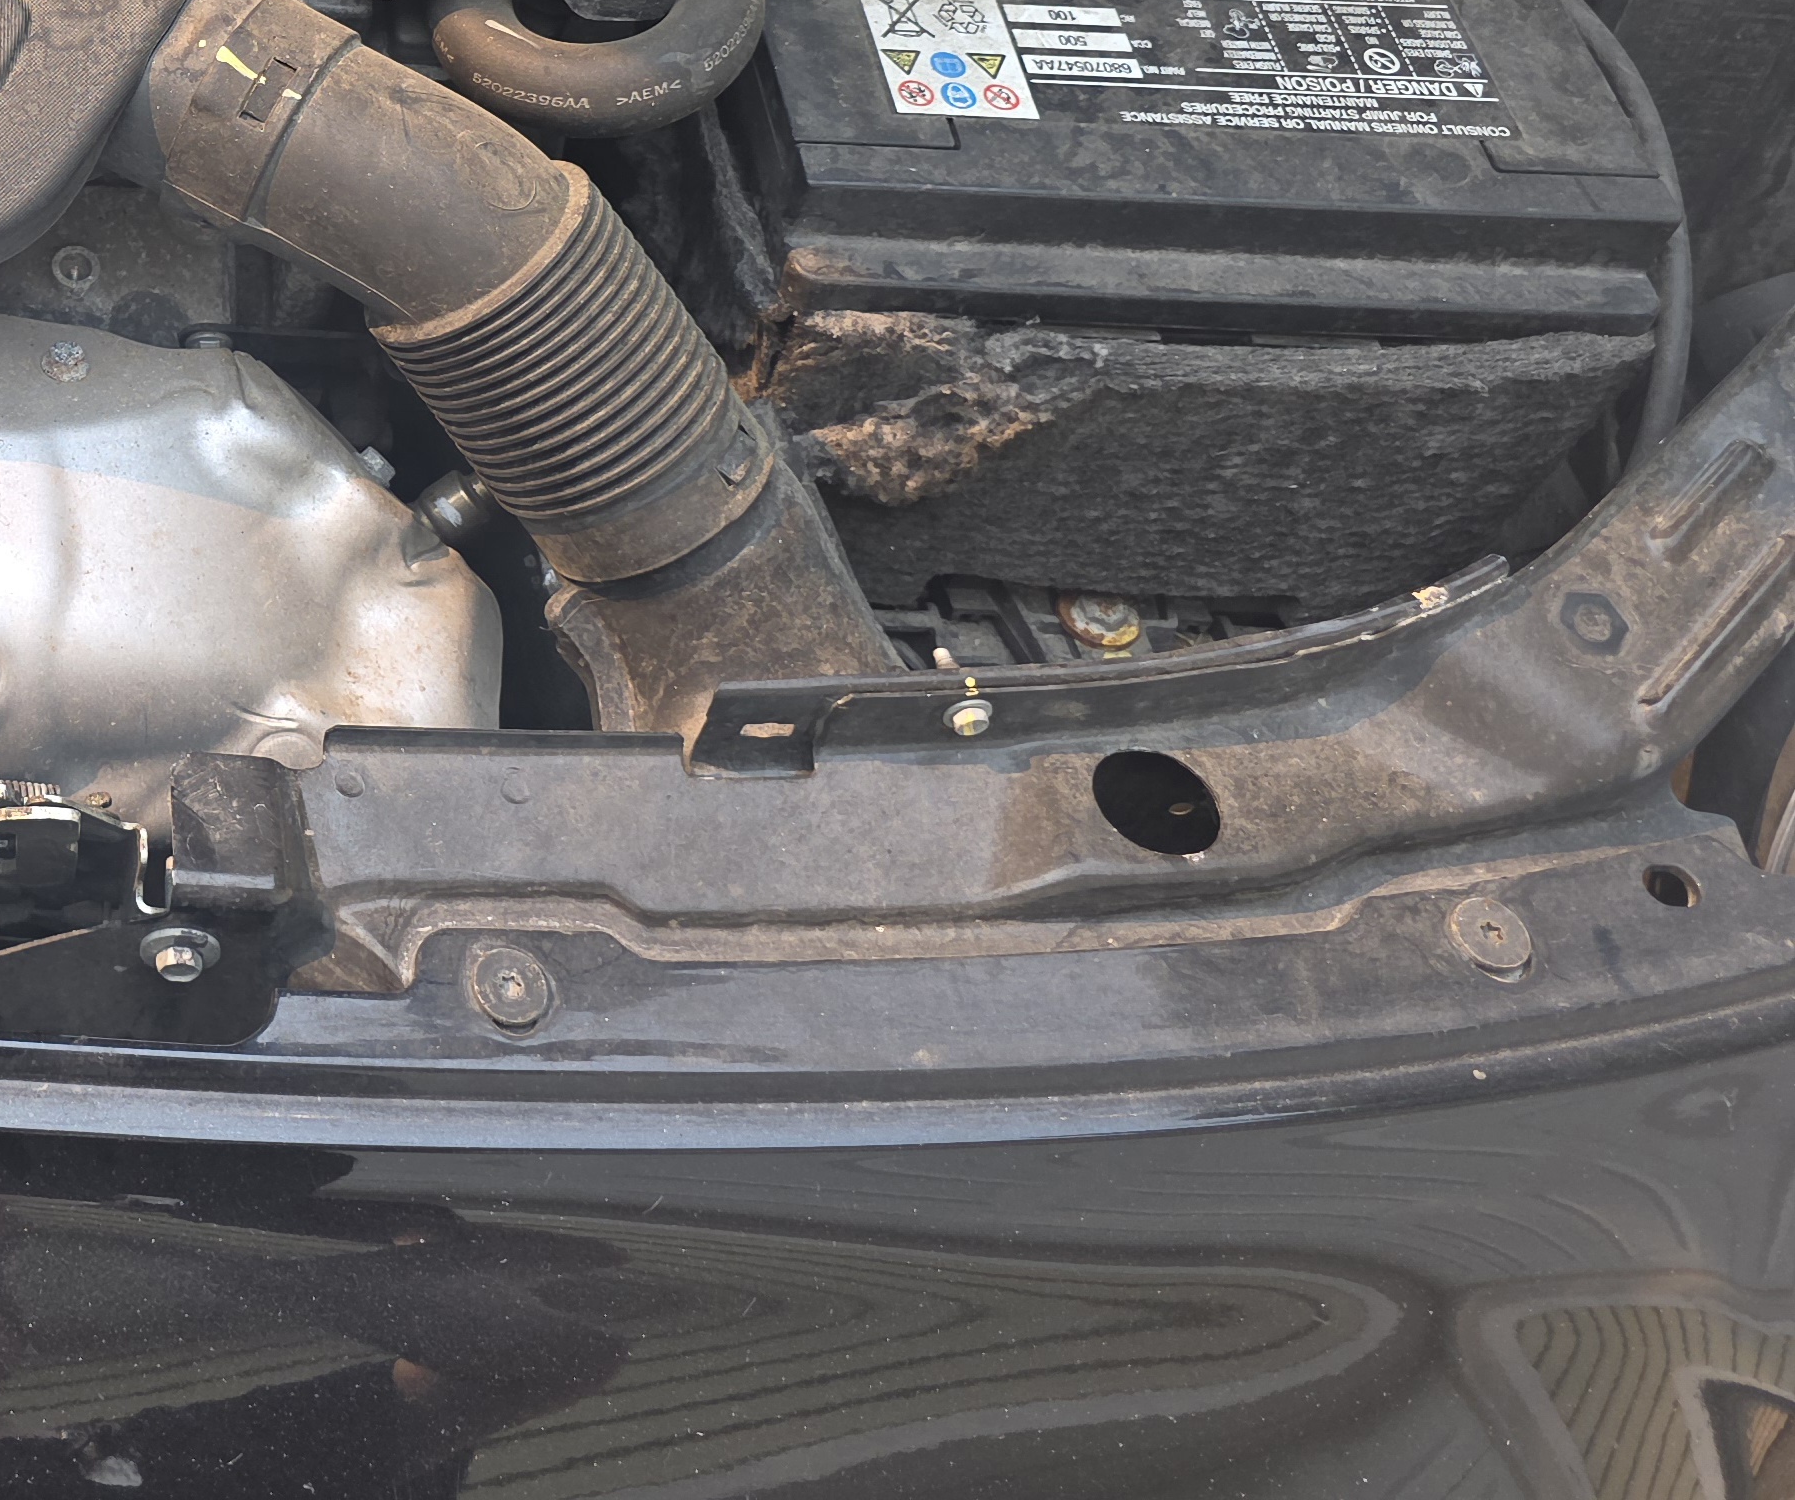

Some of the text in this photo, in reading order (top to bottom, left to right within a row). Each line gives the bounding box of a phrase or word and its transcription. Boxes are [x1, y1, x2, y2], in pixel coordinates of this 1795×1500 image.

[1048, 10, 1076, 21] 100
[1120, 14, 1135, 23] RC
[1058, 34, 1087, 47] 500
[1130, 40, 1152, 48] CCA
[1031, 59, 1132, 74] 68070547AA
[471, 71, 591, 110] 52022396AA
[1275, 76, 1457, 97] DANGER / POISON
[1228, 92, 1378, 107] MAINTENANCE FREE
[1119, 111, 1211, 125] ASSISTANCE
[1181, 102, 1437, 122] FOR JUMP STARTING PROCEDURES
[1214, 115, 1281, 127] SERVICE
[1280, 118, 1304, 128] OR
[1305, 119, 1370, 131] MANUAL
[1441, 125, 1510, 136] CONSULT
